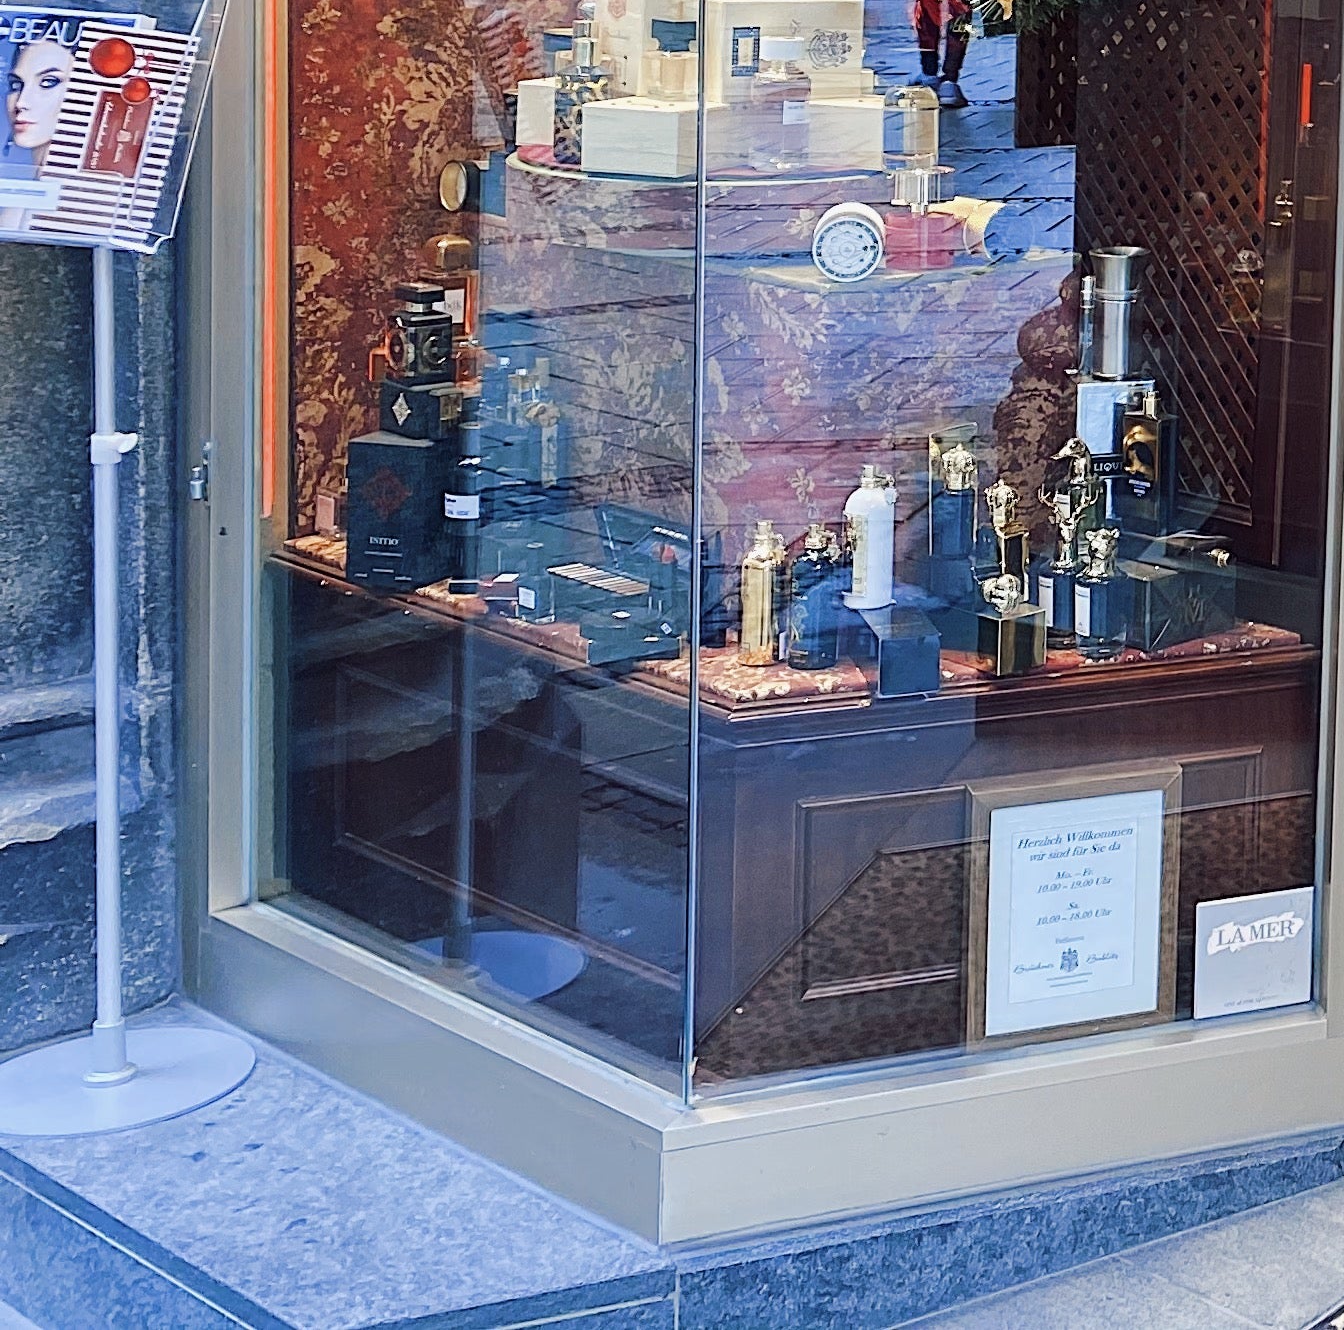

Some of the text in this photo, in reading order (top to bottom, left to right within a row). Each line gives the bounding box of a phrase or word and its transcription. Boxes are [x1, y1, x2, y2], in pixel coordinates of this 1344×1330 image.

[1017, 827, 1134, 850] Herzlich Willkommen
[1090, 843, 1106, 854] Sie
[1216, 919, 1294, 947] LA MER
